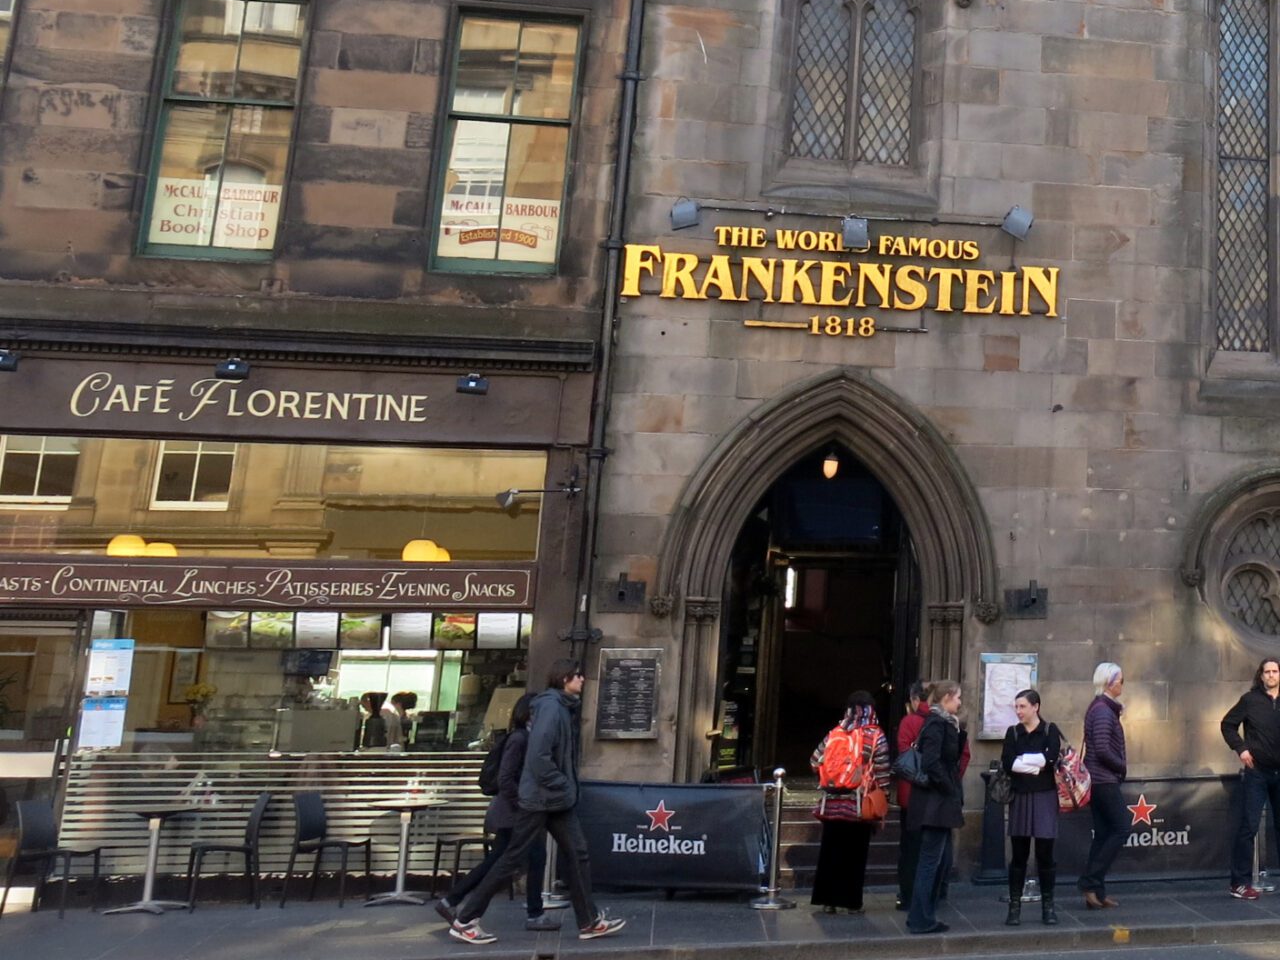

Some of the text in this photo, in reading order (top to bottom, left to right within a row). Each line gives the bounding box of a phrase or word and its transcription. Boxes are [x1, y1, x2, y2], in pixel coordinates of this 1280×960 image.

[223, 188, 279, 203] BARBOUR
[173, 203, 266, 222] Christian
[505, 203, 559, 218] BARBOUR
[159, 219, 270, 240] Book Shop
[514, 231, 536, 246] 1900
[714, 226, 981, 261] THE WORL FAMOUS
[620, 244, 1060, 317] FRANKENSTEIN
[807, 314, 876, 338] 1818
[178, 378, 429, 423] FLORENTINE
[612, 833, 706, 855] Heineken
